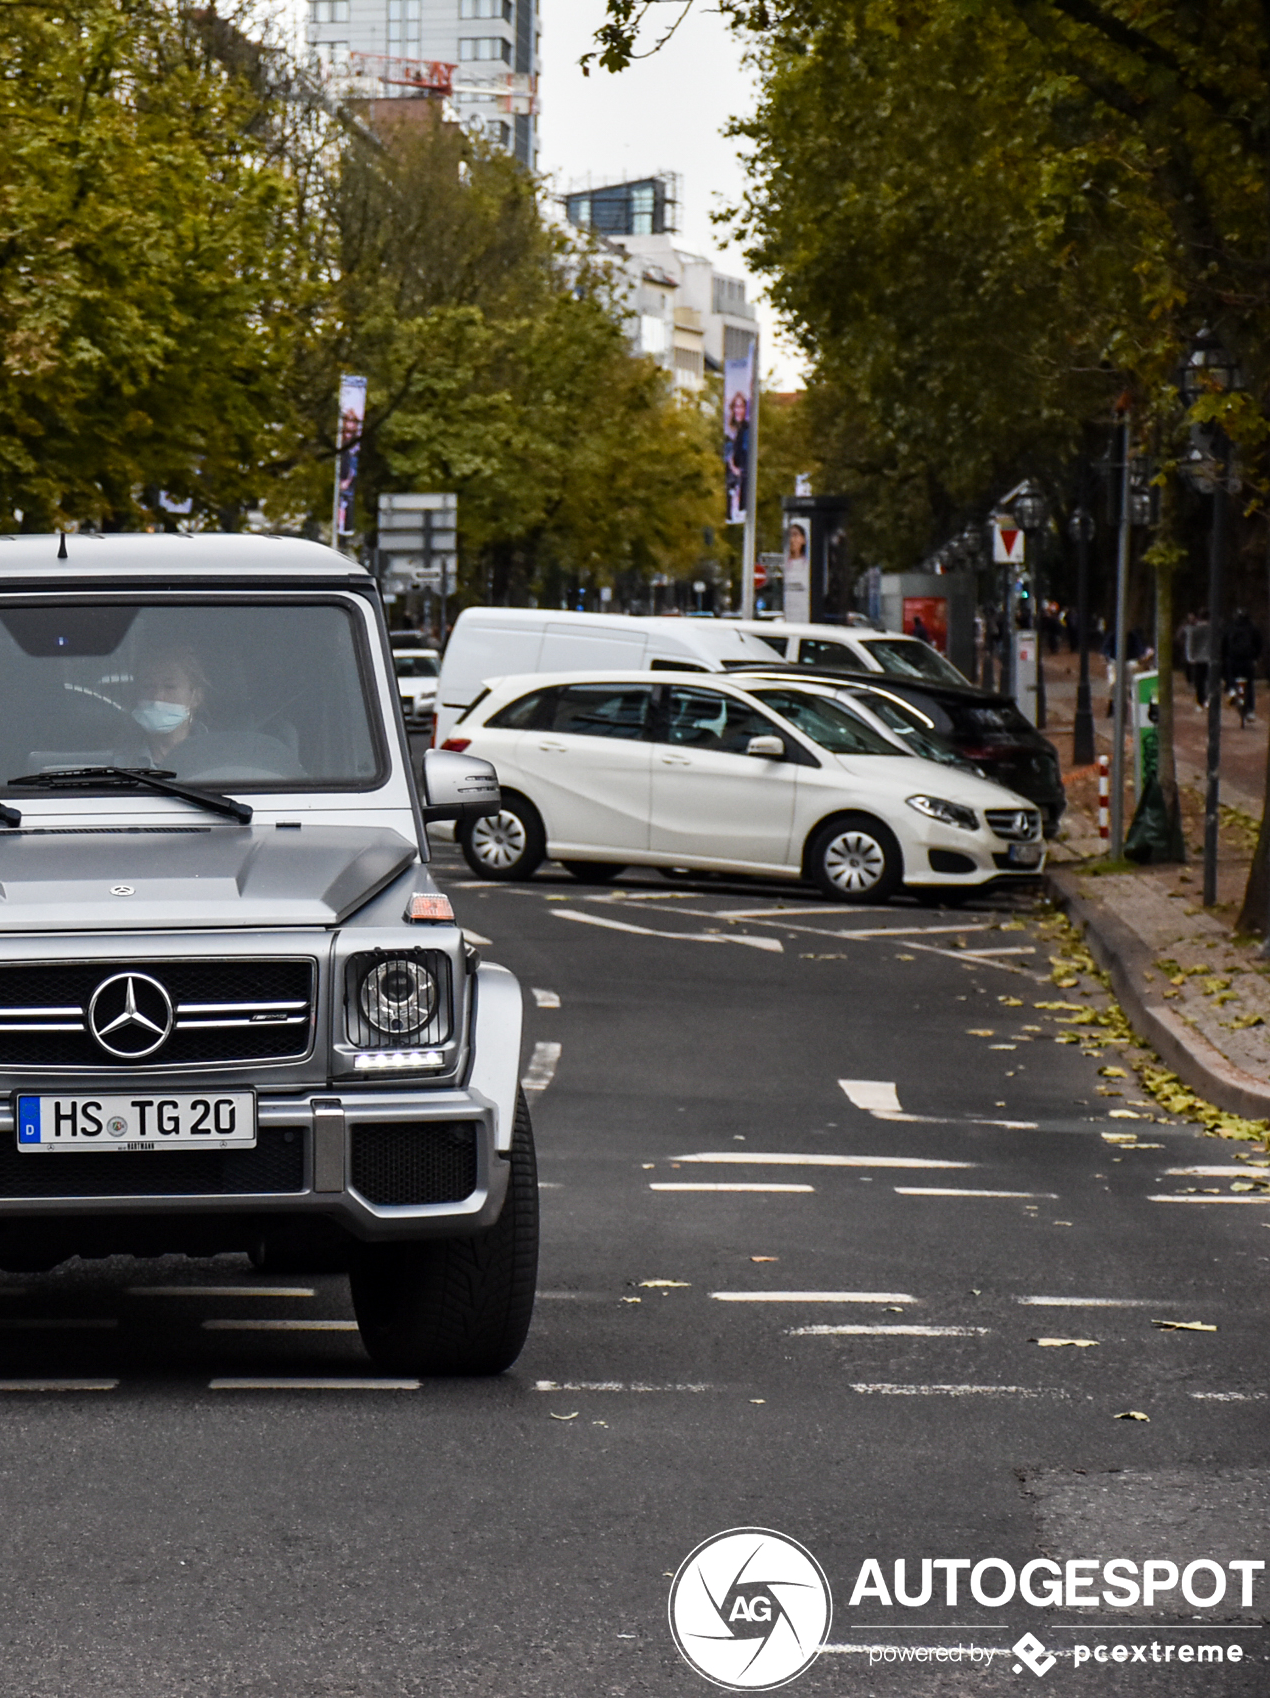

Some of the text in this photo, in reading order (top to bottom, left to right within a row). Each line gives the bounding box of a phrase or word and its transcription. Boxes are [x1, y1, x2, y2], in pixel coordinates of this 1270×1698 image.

[54, 1098, 236, 1137] HS TG 20
[25, 1124, 35, 1136] D
[127, 1142, 154, 1150] HARTMANN
